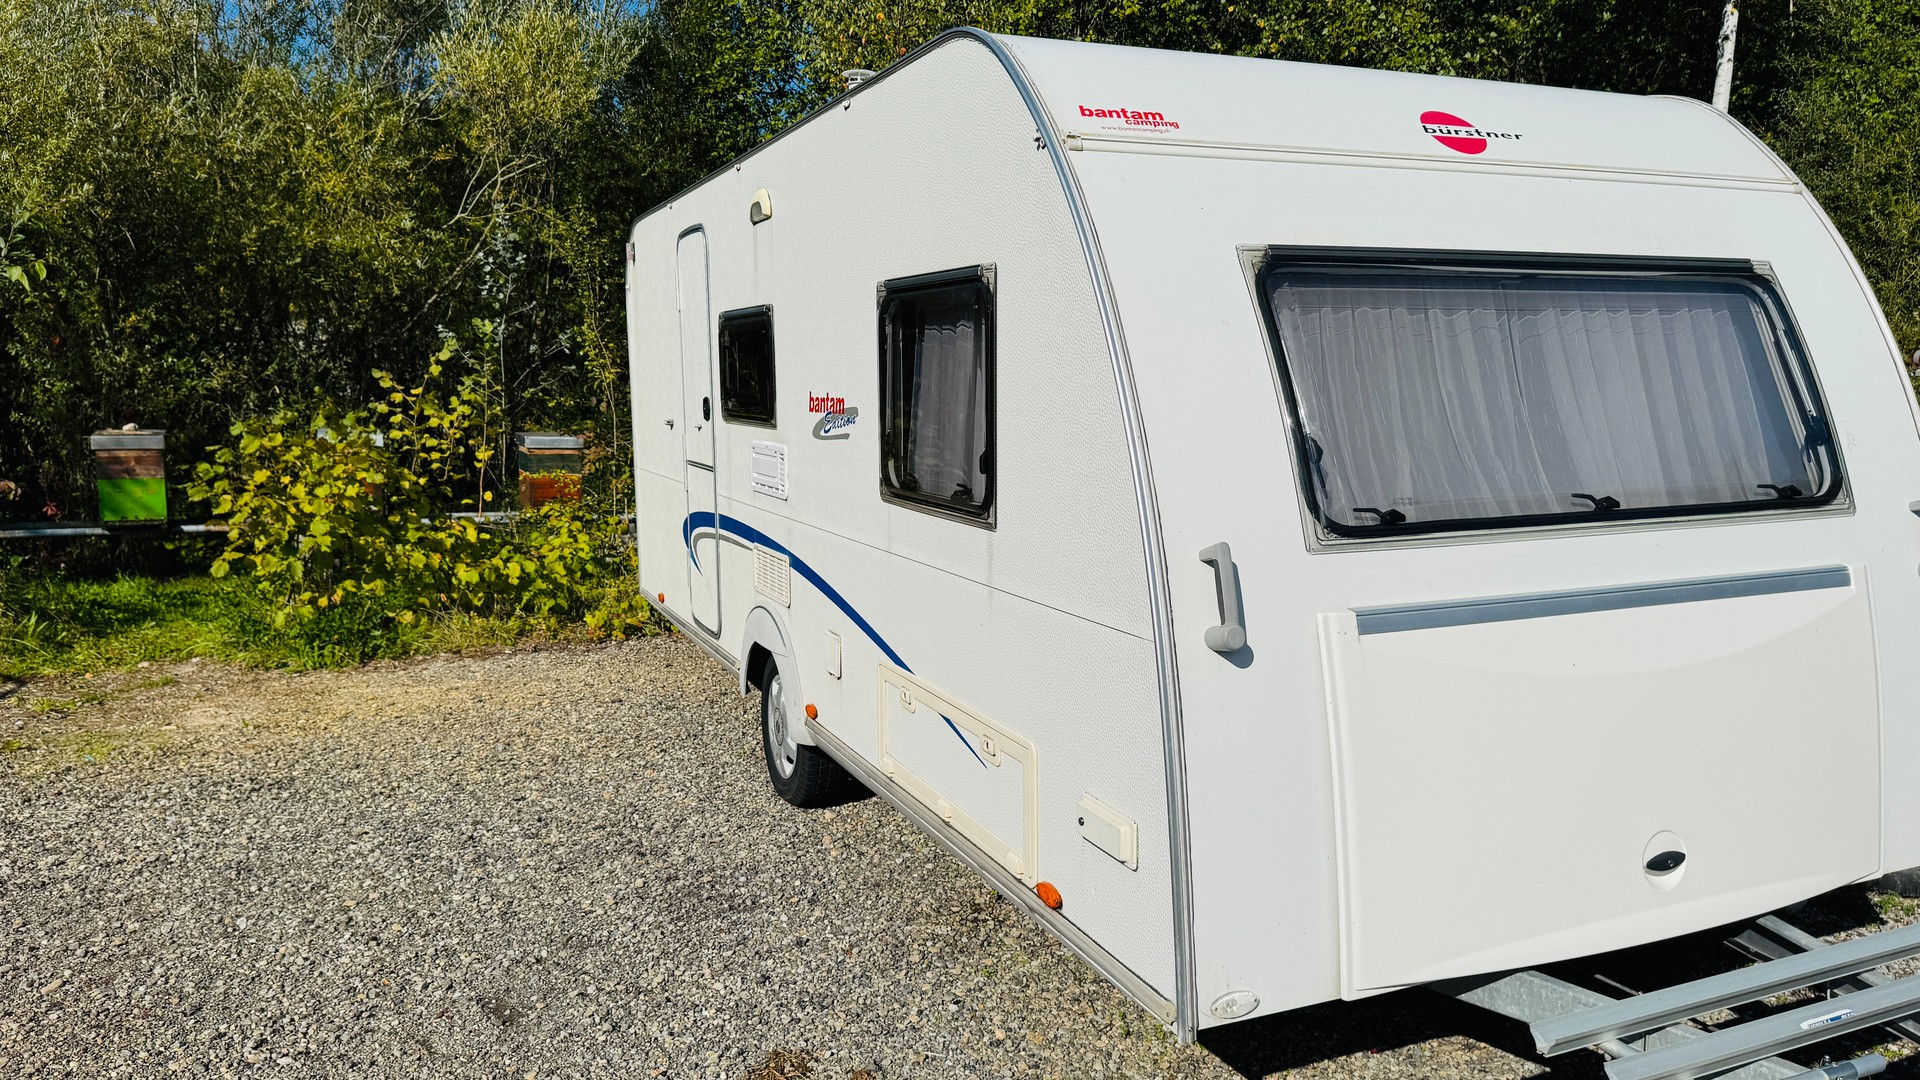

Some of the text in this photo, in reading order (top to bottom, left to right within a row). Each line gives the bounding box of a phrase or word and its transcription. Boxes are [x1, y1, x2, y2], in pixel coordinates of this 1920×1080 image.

[1079, 105, 1164, 121] bantam
[1125, 119, 1180, 129] camping
[1422, 125, 1523, 140] bürstner
[809, 391, 845, 415] bantam
[823, 411, 857, 434] Edition
